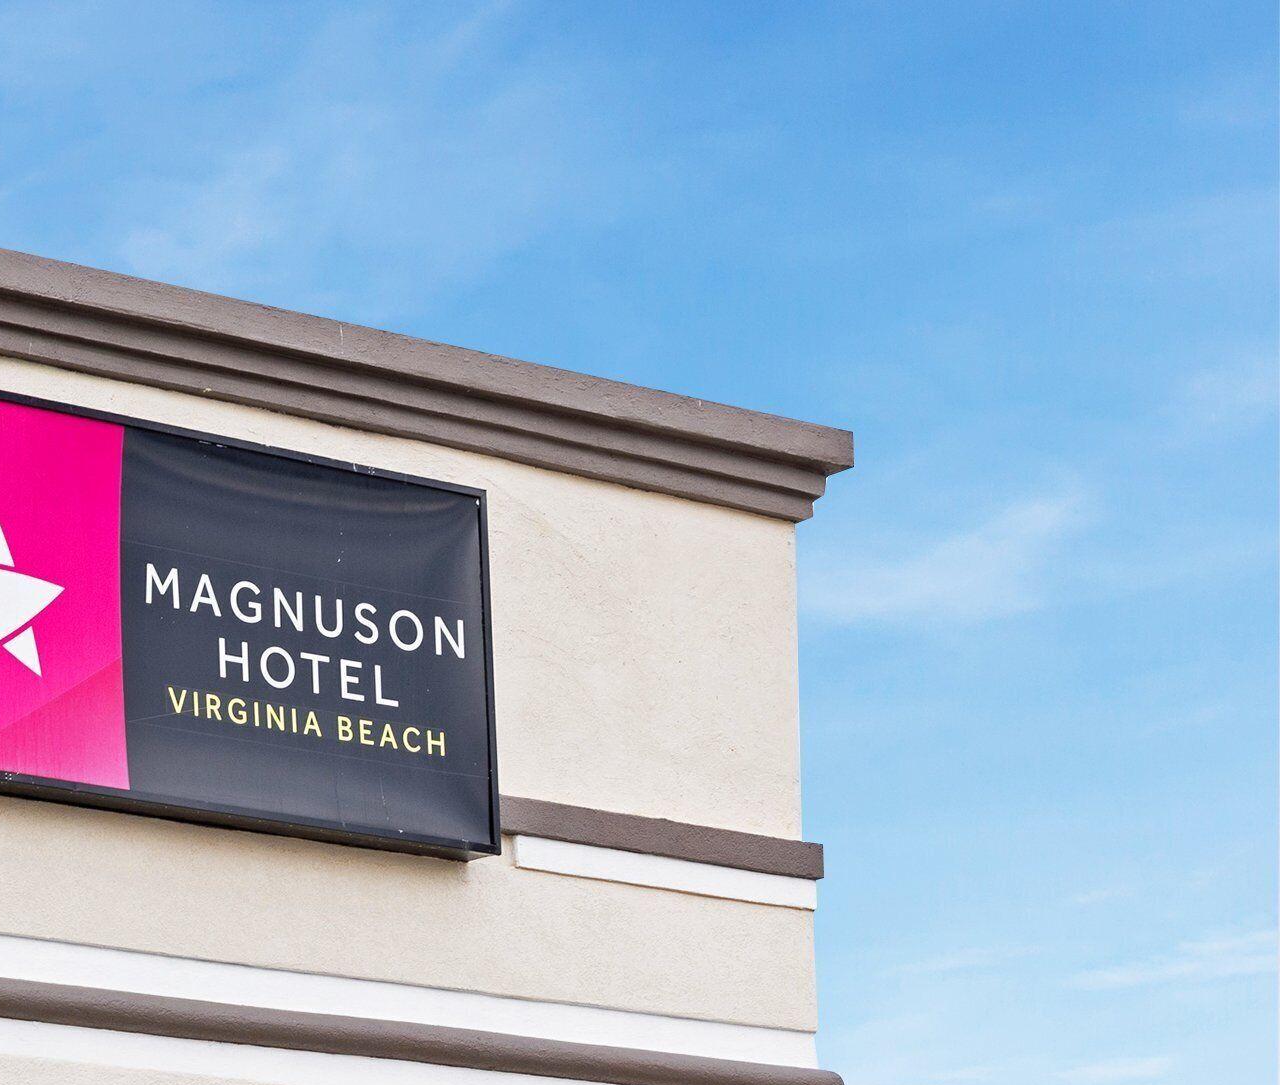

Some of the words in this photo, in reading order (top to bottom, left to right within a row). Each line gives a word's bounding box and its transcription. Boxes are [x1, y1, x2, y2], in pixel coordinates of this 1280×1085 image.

[145, 563, 465, 659] MAGNUSON
[218, 637, 400, 708] HOTEL
[167, 686, 323, 737] VIRGINIA
[337, 715, 447, 757] BEACH
